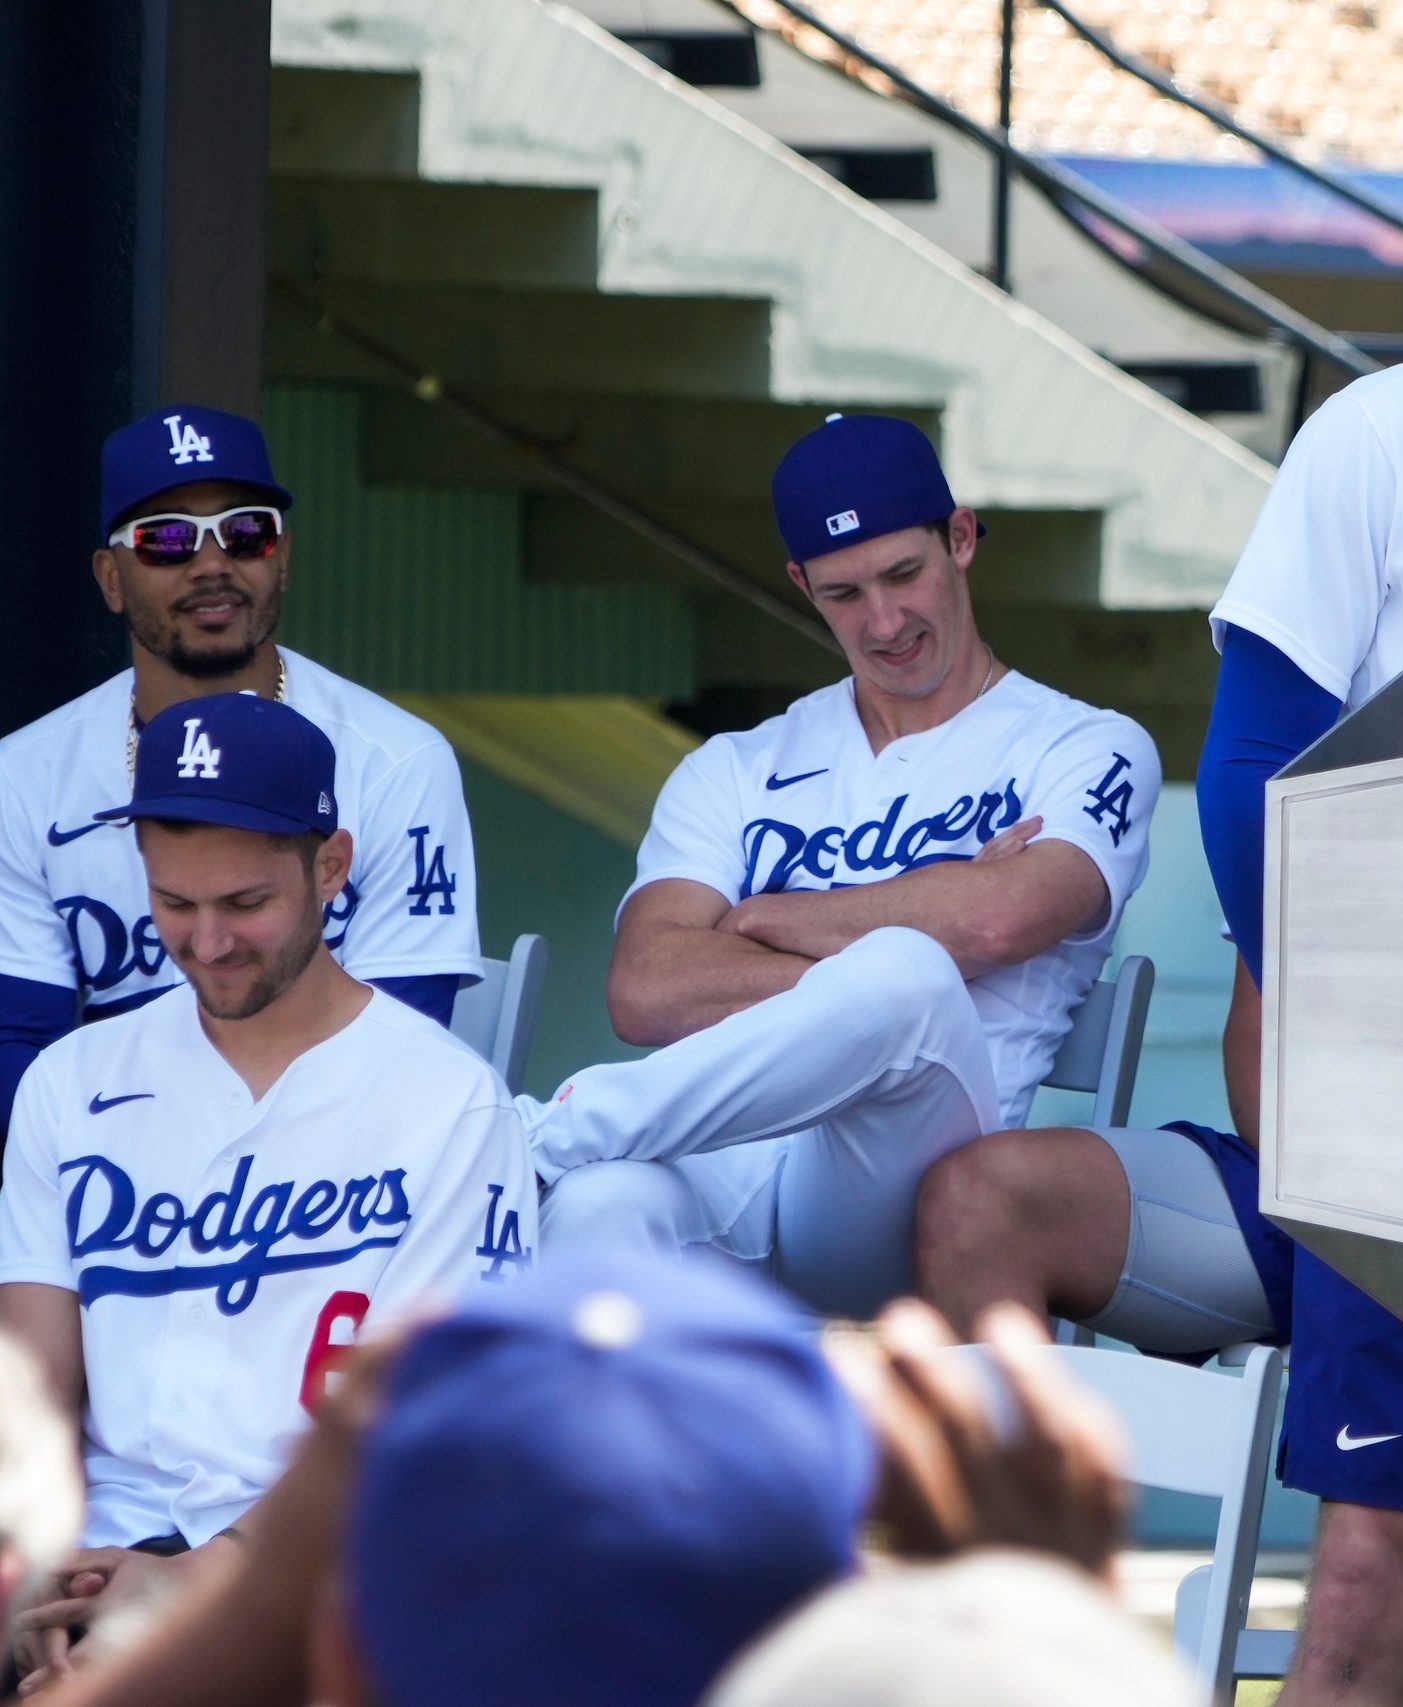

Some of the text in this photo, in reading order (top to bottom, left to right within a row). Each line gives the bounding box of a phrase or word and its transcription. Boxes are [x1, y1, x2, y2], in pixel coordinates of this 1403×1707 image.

[163, 414, 214, 465] LA
[177, 718, 221, 778] LA
[1083, 752, 1134, 847] LA
[408, 825, 456, 916] LA
[58, 1154, 412, 1317] Dodgers
[475, 1183, 533, 1284] LA
